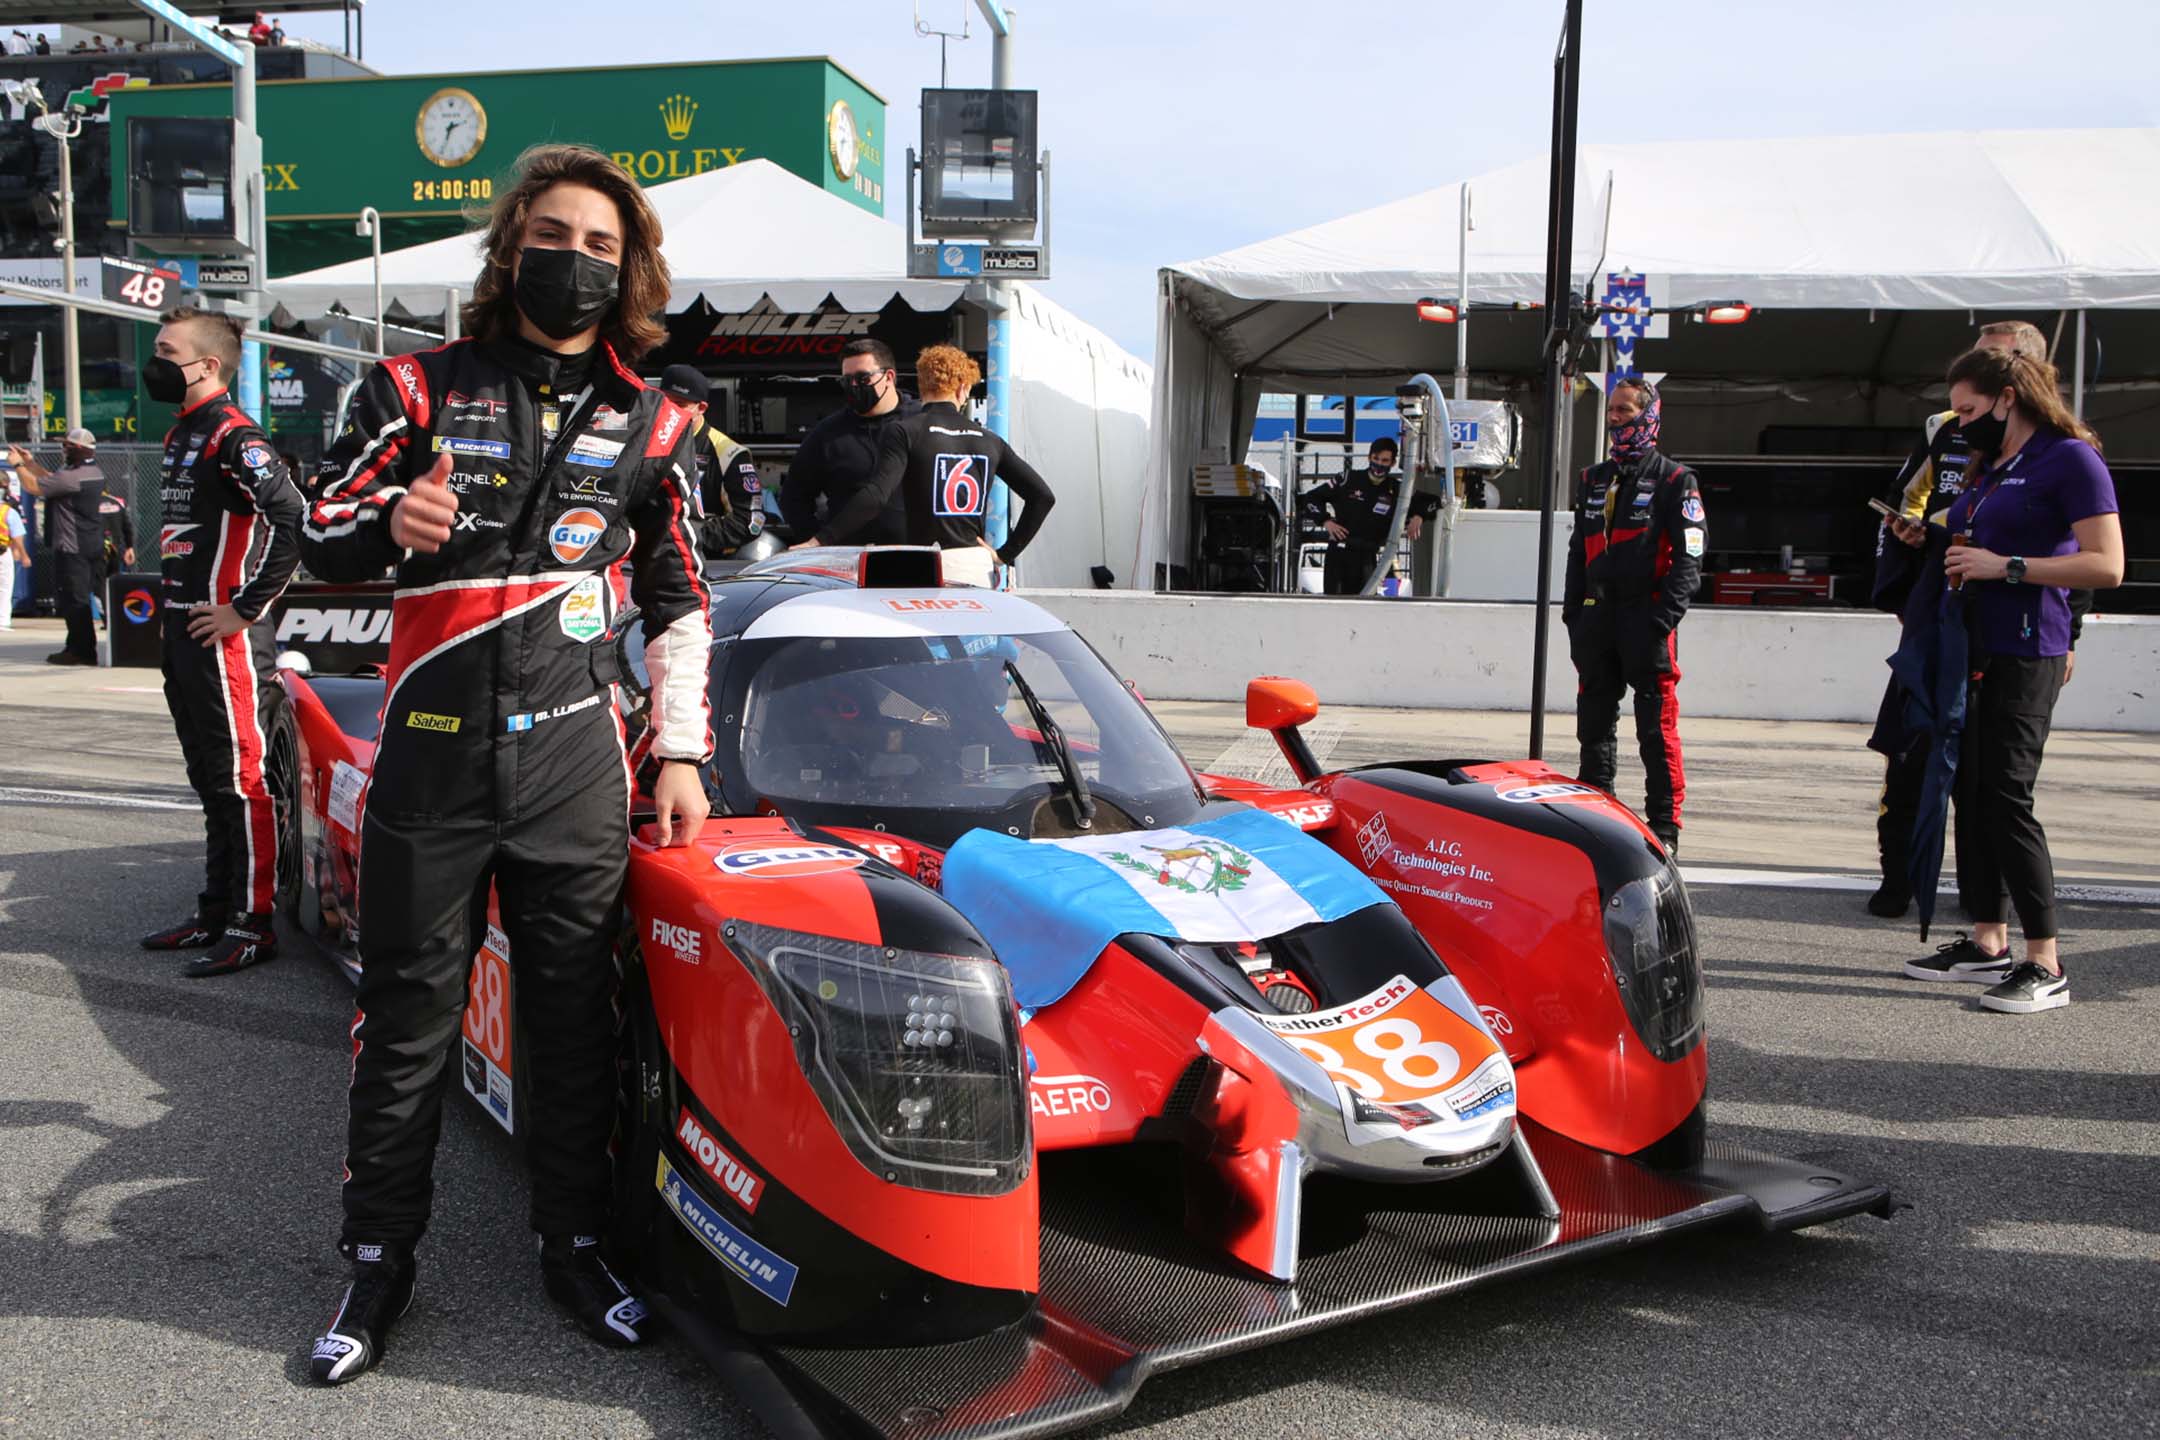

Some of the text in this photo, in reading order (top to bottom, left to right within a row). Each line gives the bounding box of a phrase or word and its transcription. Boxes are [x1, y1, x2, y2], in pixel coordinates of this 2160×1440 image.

[413, 178, 492, 201] 24:00:00
[17, 276, 89, 288] Motorsrt
[121, 272, 165, 307] 48
[1609, 296, 1642, 326] 81
[711, 313, 880, 336] MILLER
[697, 335, 848, 357] RACING
[1451, 423, 1472, 441] 81
[454, 441, 504, 454] MICHELIN
[943, 457, 980, 515] 6
[597, 495, 618, 506] CARE
[566, 594, 595, 612] 24
[888, 599, 983, 611] LMP3
[412, 714, 455, 730] Sabelt
[1425, 837, 1462, 857] A.I.G.
[1392, 849, 1494, 883] Technologies Inc.
[652, 917, 702, 957] FIKSE
[468, 952, 505, 1062] 38
[1277, 1018, 1461, 1099] 38
[1031, 1086, 1112, 1118] AERO
[680, 1117, 756, 1206] MOTUL
[357, 1247, 382, 1259] OMP
[682, 1200, 780, 1283] MICHELIN
